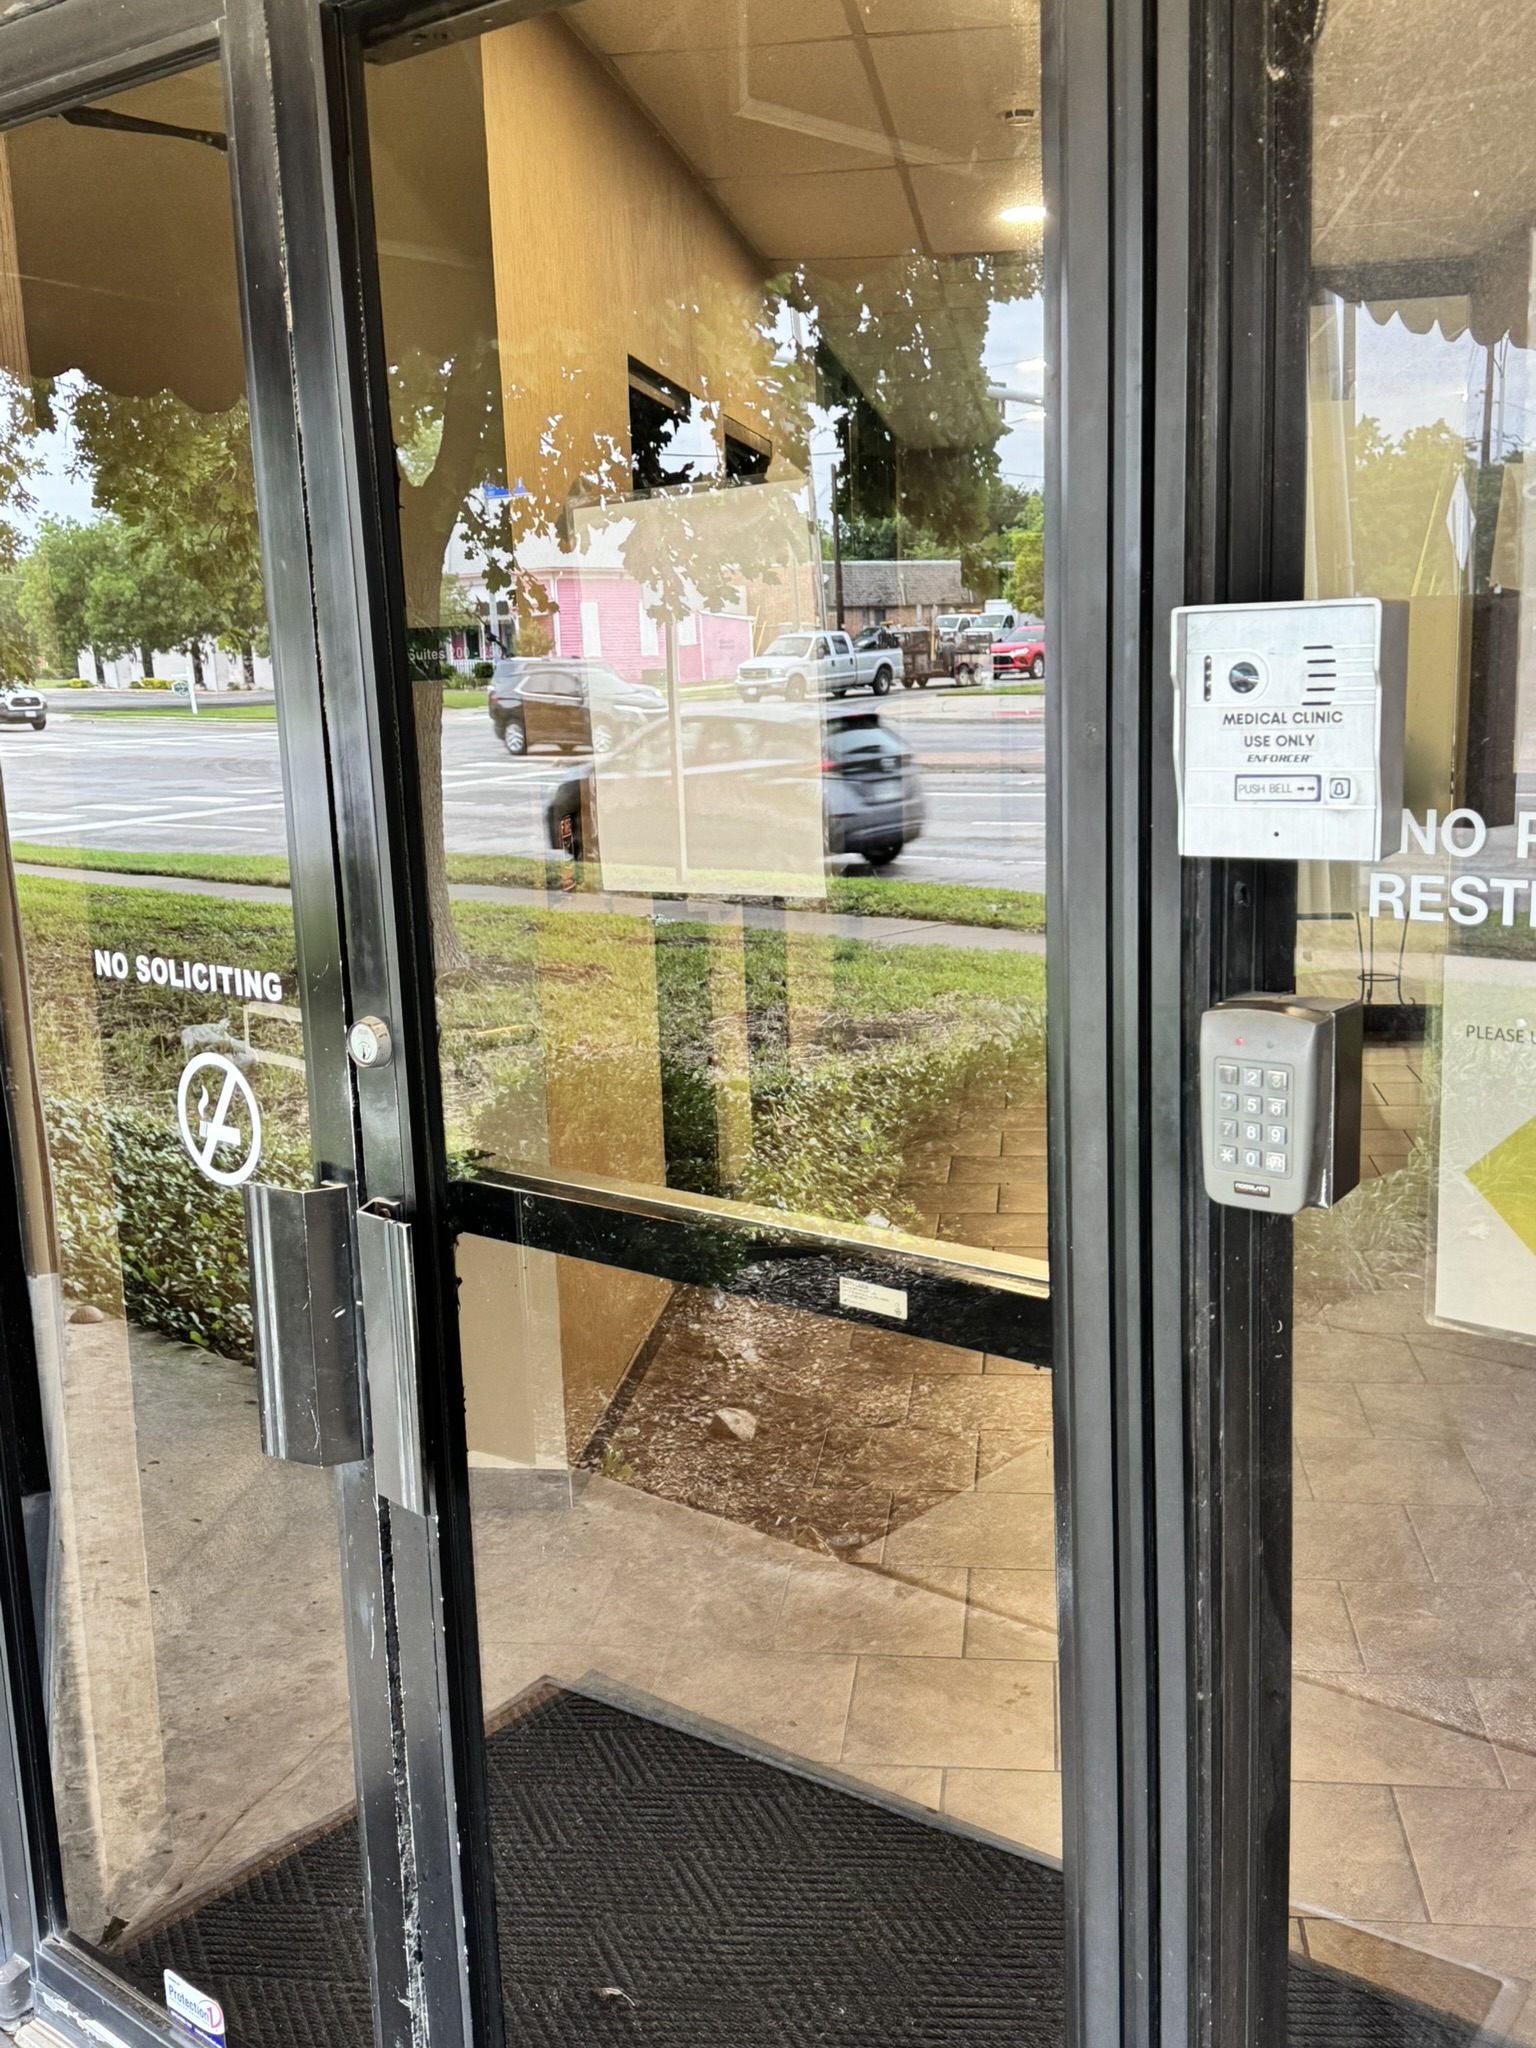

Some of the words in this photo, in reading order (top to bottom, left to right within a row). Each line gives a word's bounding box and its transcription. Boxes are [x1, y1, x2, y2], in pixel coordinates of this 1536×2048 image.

[408, 648, 446, 661] Suites
[1223, 712, 1287, 725] MEDICAL
[1293, 711, 1343, 724] CLINIC
[1244, 735, 1271, 747] USE
[1276, 734, 1315, 747] ONLY
[1247, 754, 1310, 763] ENFORCER
[1239, 784, 1266, 794] PUSH
[1269, 783, 1293, 794] BELL
[1399, 807, 1487, 858] NO
[1369, 873, 1536, 929] REST
[94, 949, 129, 980] NO
[135, 954, 282, 1001] SOLICITING
[1466, 1024, 1525, 1044] PLEASE
[1247, 1071, 1257, 1084] 2
[1247, 1098, 1256, 1111] 5
[1271, 1103, 1281, 1115] 6
[1223, 1122, 1232, 1135] 7
[1246, 1125, 1256, 1139] 8
[1271, 1128, 1280, 1142] 9
[1245, 1152, 1256, 1166] 0
